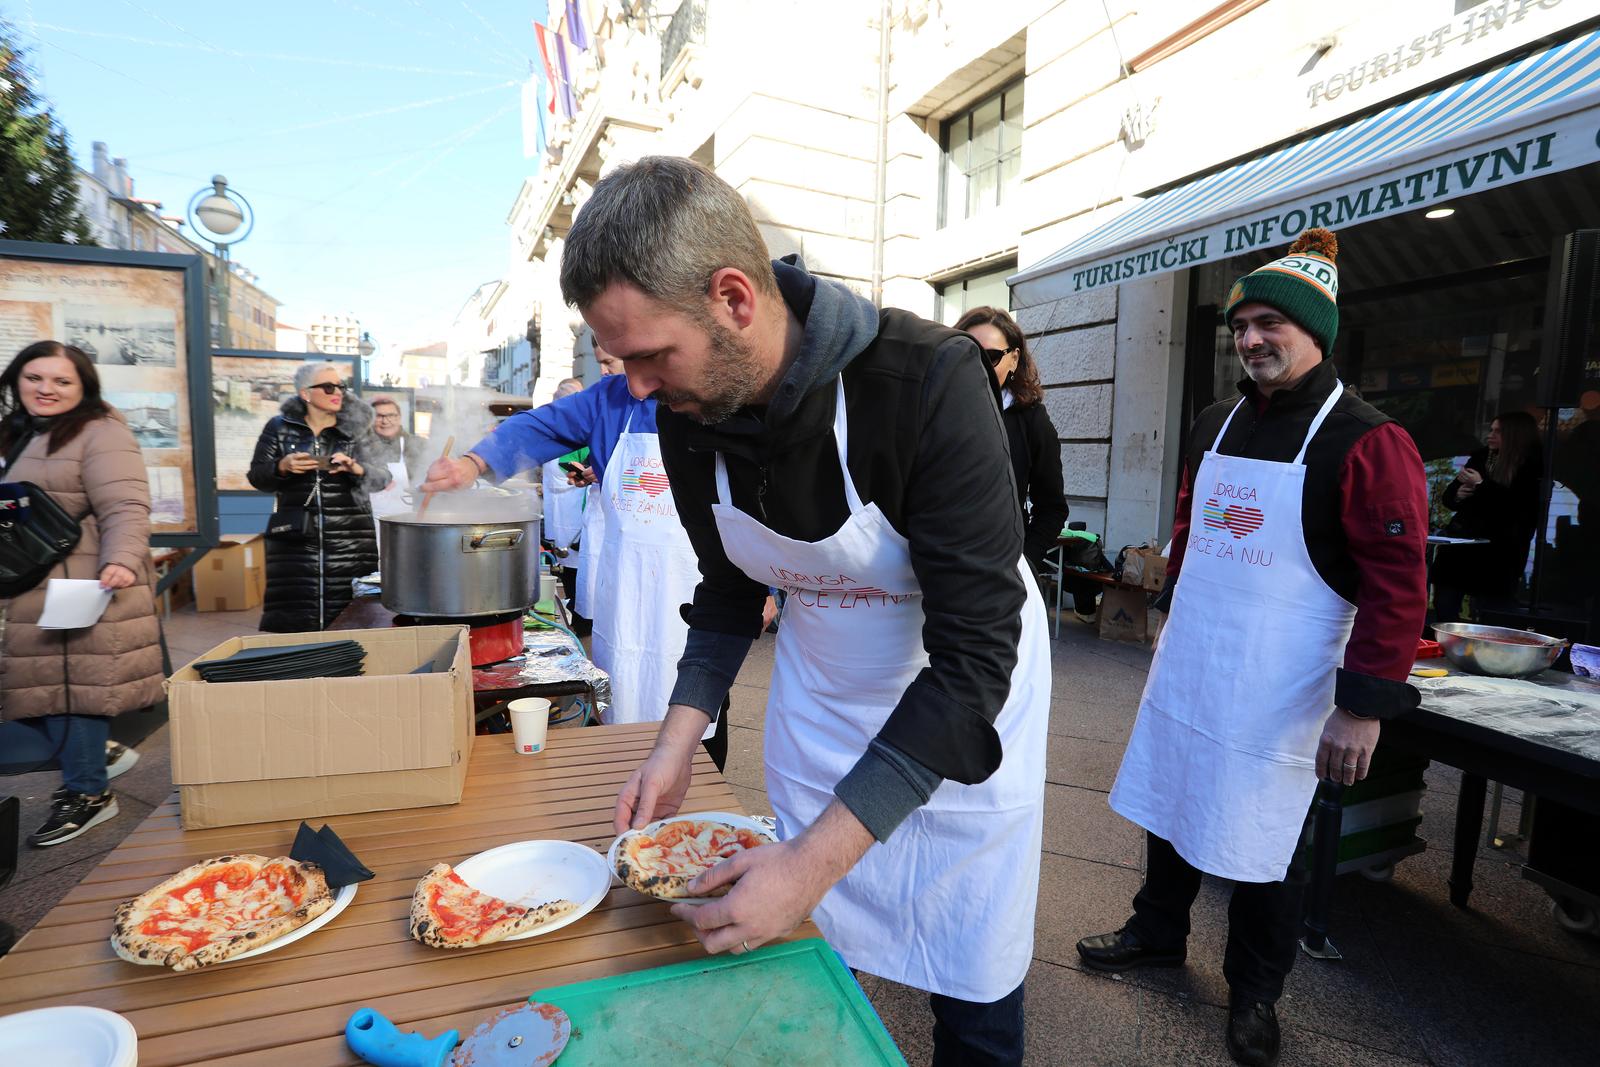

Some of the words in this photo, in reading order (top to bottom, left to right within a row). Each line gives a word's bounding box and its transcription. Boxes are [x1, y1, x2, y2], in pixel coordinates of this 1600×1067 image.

[1307, 24, 1452, 109] TOURIST
[1073, 235, 1208, 291] TURISTIČKI
[1224, 132, 1557, 254] INFORMATIVNI
[1216, 542, 1234, 561] ZA
[1240, 547, 1273, 567] NJU
